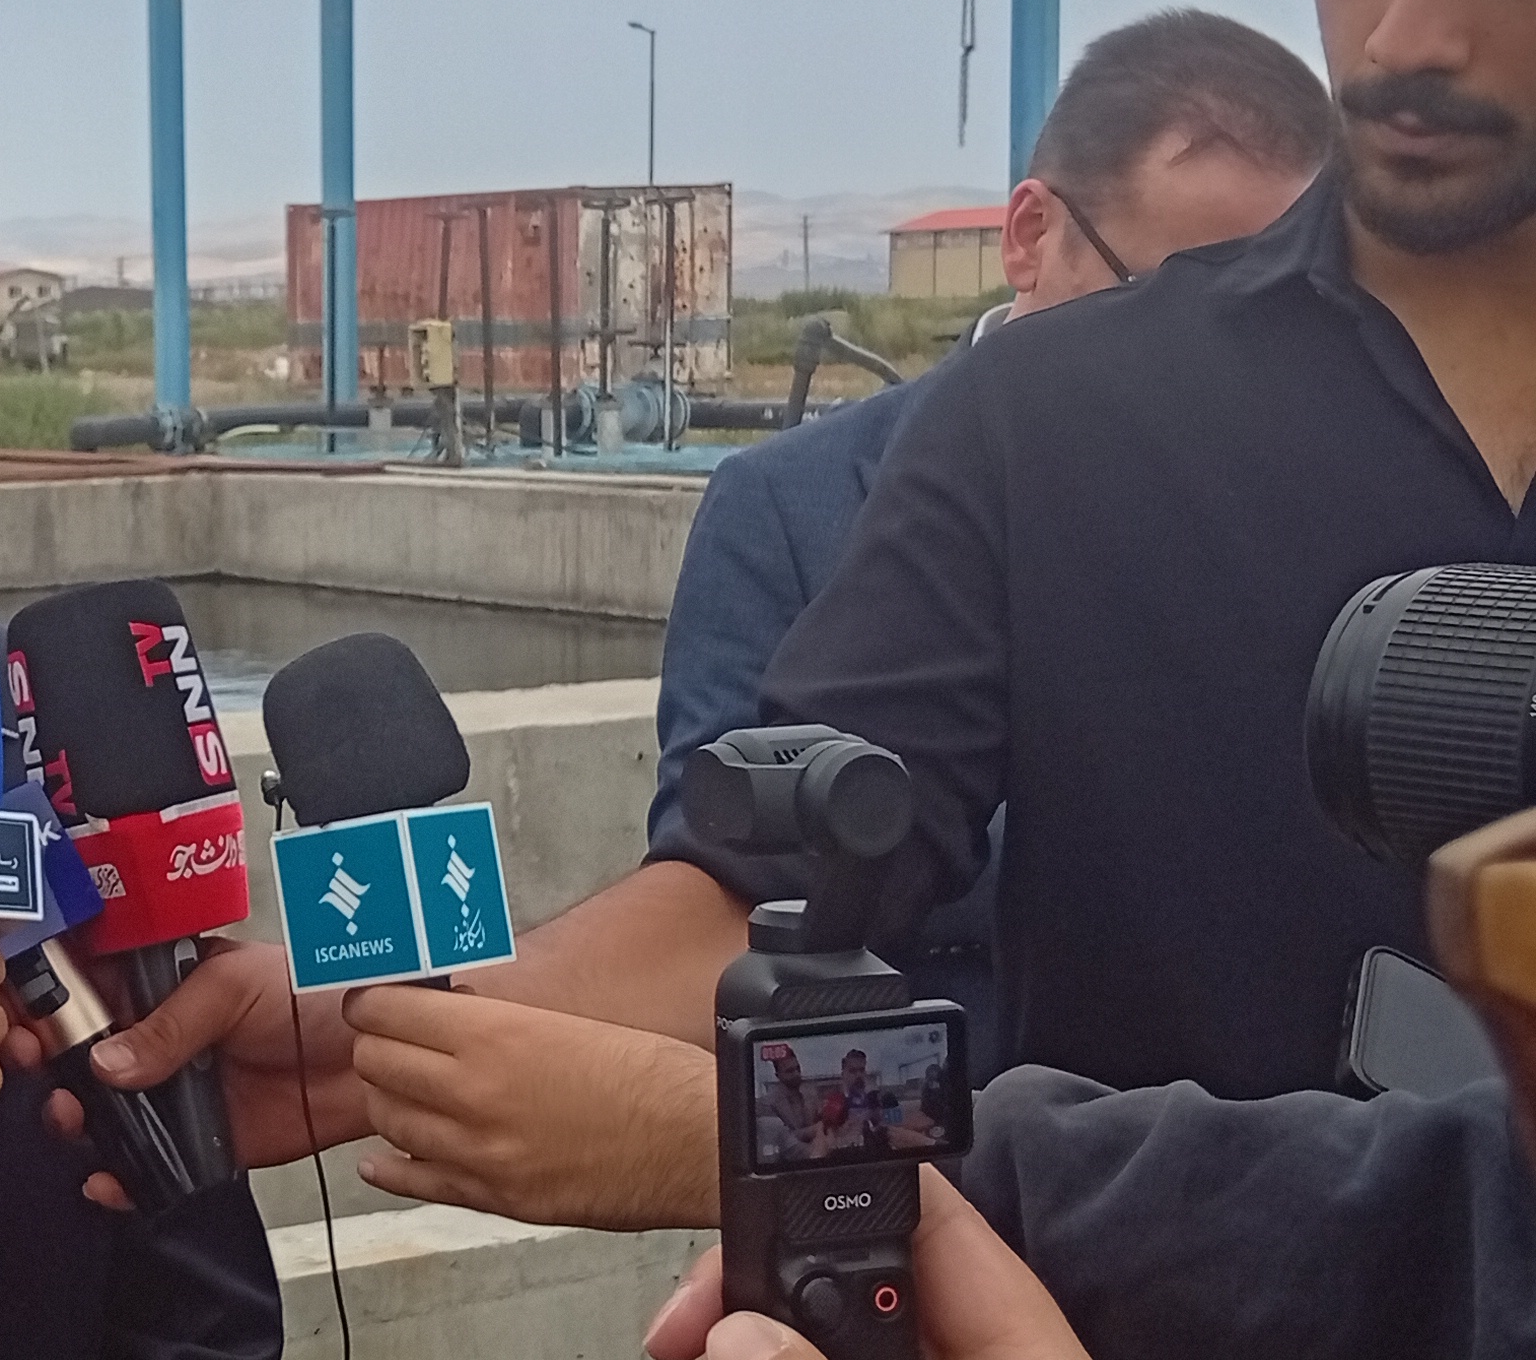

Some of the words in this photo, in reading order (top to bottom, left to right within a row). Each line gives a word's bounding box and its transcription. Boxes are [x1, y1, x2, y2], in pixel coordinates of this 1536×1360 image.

[128, 621, 172, 687] TV
[162, 625, 228, 777] SNN
[315, 937, 394, 964] ISCANEWS
[824, 1192, 872, 1211] OSMO
